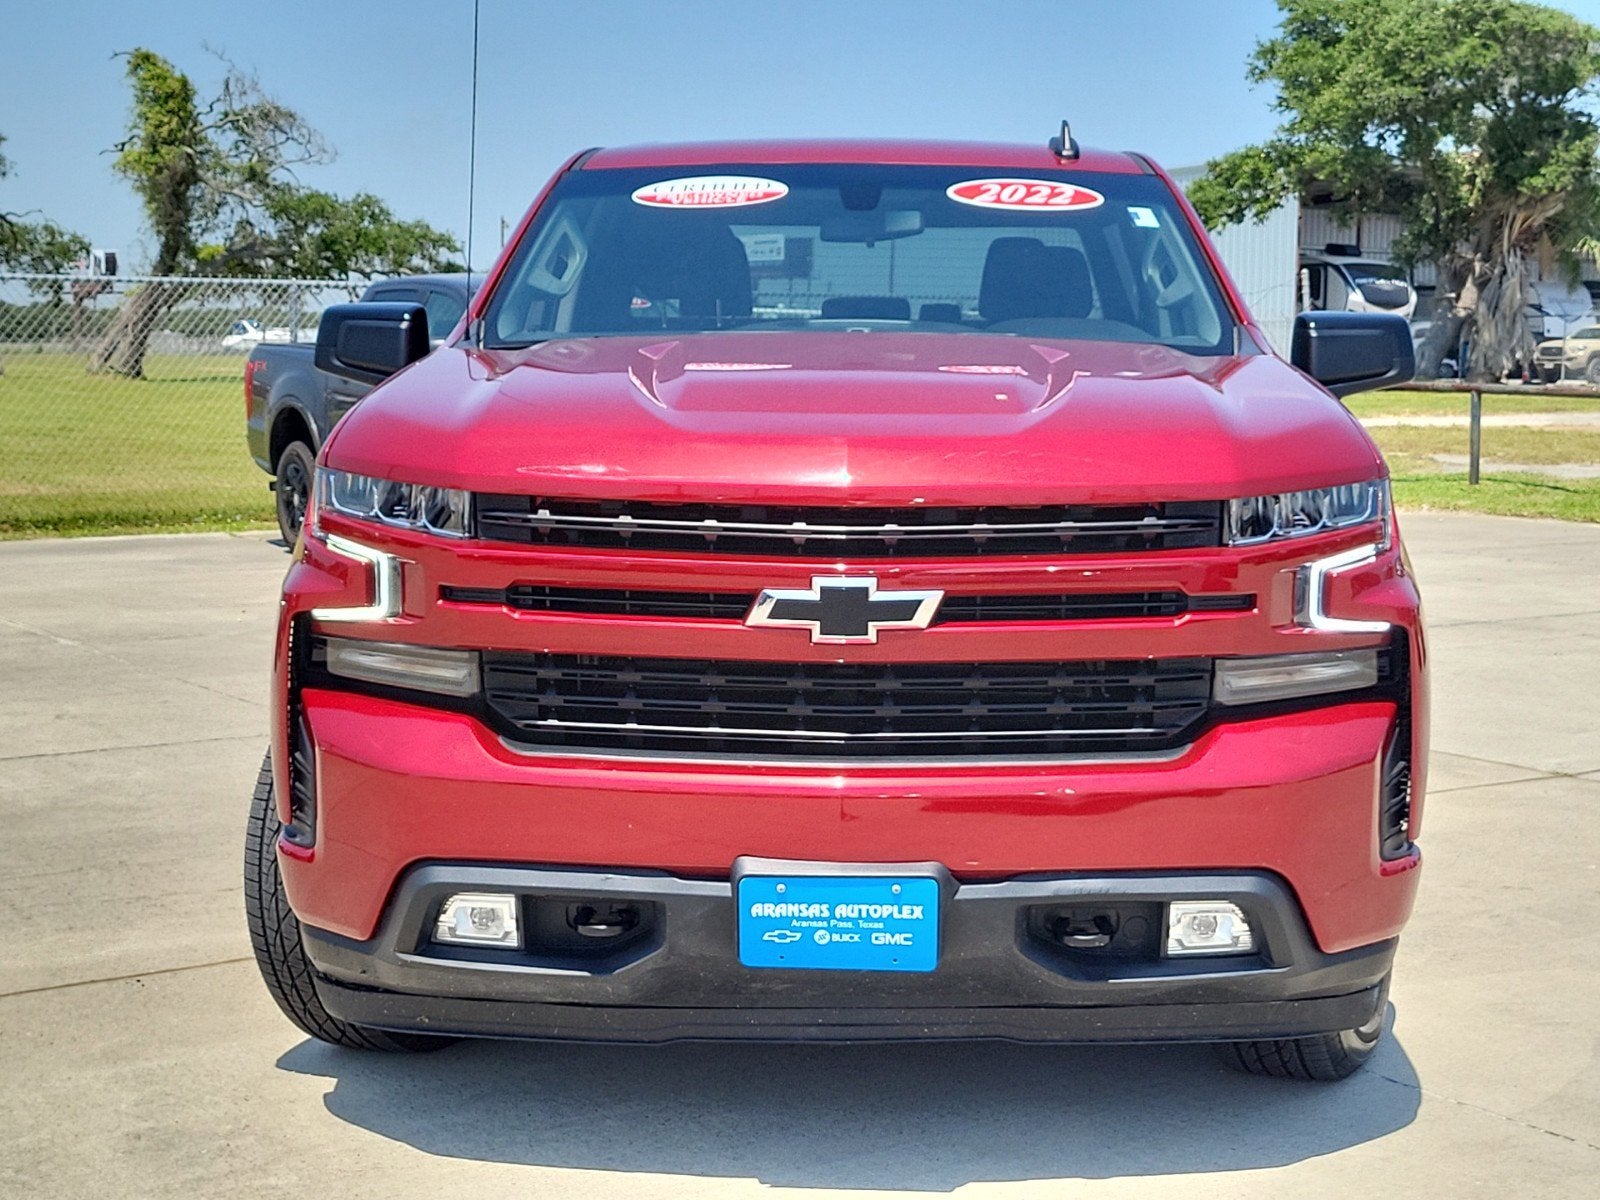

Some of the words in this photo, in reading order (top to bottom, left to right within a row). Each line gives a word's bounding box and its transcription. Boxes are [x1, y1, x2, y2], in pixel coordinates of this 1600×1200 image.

[973, 183, 1076, 205] 2022
[750, 903, 830, 918] ARANSAS
[834, 904, 924, 920] AUTOPLEX
[791, 919, 828, 928] Aransas
[858, 920, 885, 929] Texas
[831, 933, 861, 943] BUICK
[870, 932, 914, 946] GMC
